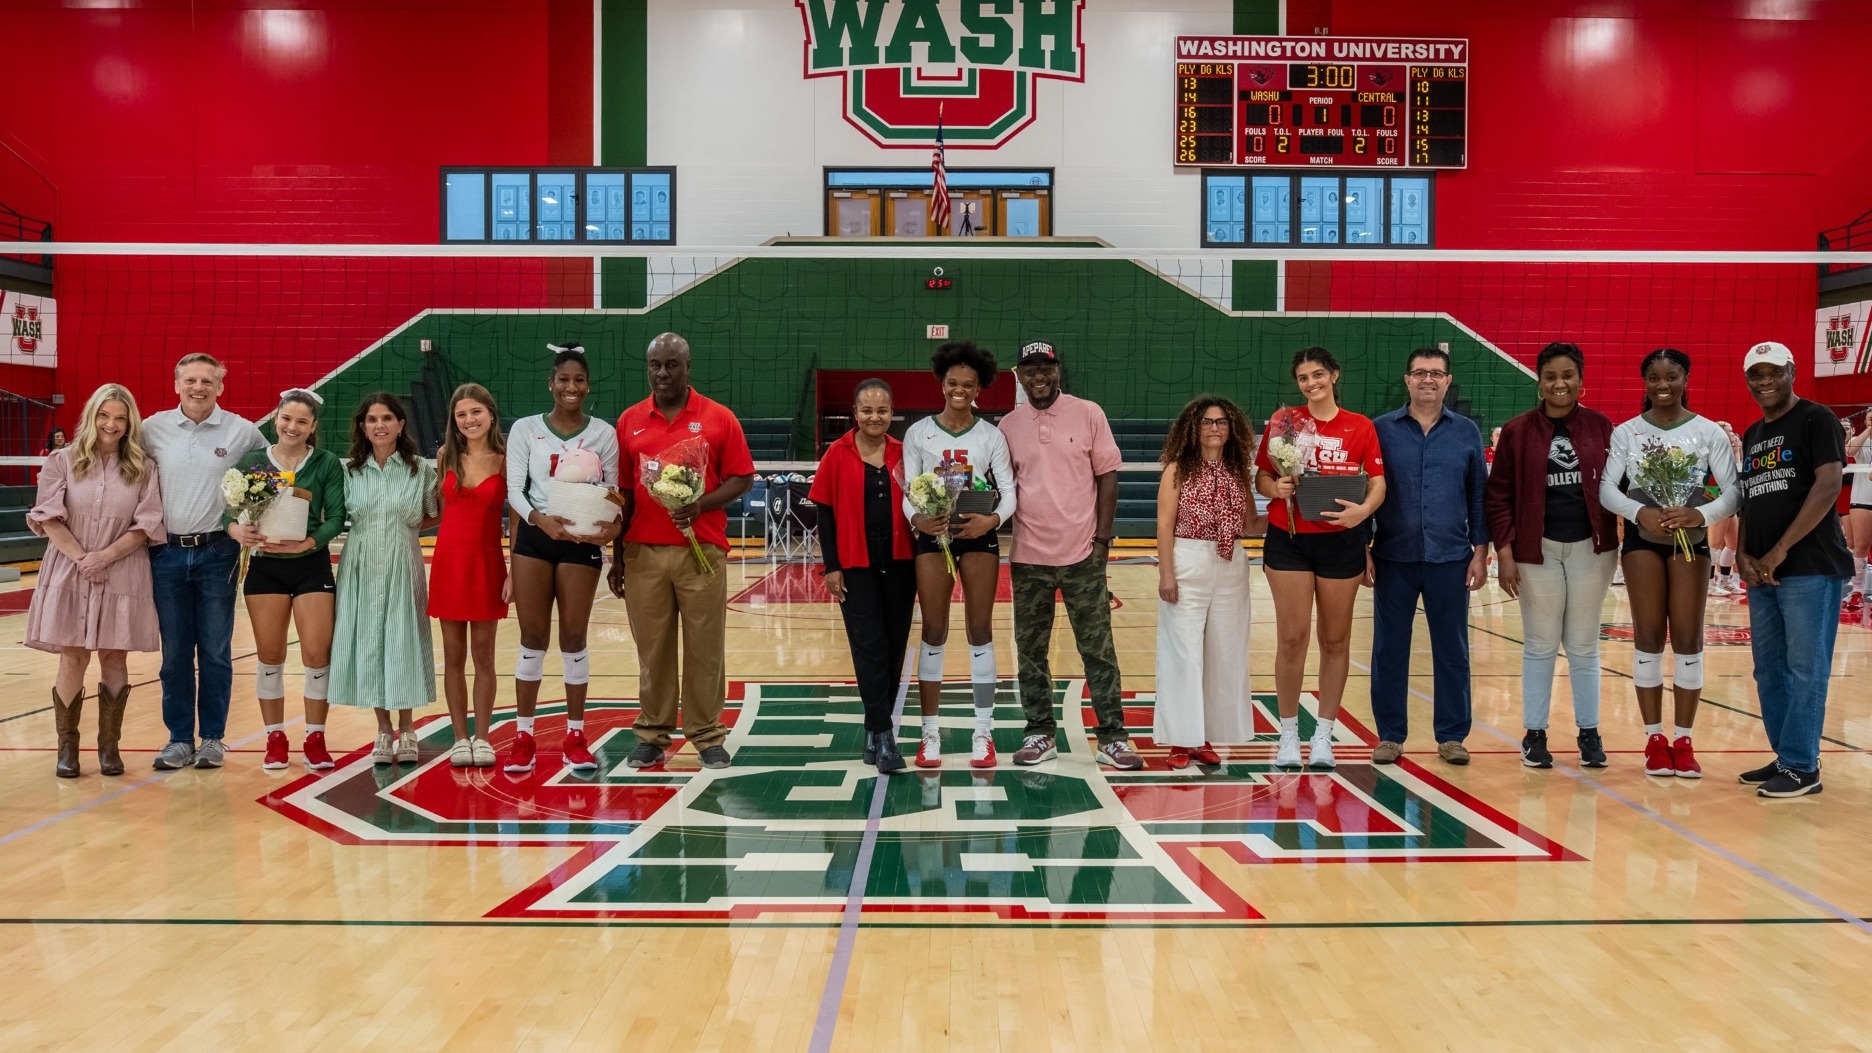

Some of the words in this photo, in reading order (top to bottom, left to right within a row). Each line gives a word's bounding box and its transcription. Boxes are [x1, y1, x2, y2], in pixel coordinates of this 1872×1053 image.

[805, 0, 1076, 73] WASH
[1179, 40, 1326, 57] WASHINGTON
[1333, 42, 1464, 59] UNIVERSITY
[1179, 64, 1196, 74] PLY
[1200, 64, 1212, 74] DG
[1215, 64, 1233, 75] KLS
[1307, 65, 1353, 87] 3:00
[1411, 68, 1428, 78] PLY
[1433, 68, 1444, 78] DG
[1448, 68, 1465, 78] KLS
[1184, 77, 1197, 90] 13
[1417, 81, 1429, 93] 10
[1184, 92, 1197, 102] 14
[1250, 91, 1280, 101] WASHU
[1309, 97, 1333, 105] PERIOD
[1358, 92, 1397, 103] CENTRAL
[1417, 96, 1429, 106] 11
[1184, 106, 1197, 119] 16
[1268, 104, 1280, 125] 0
[1383, 106, 1395, 126] 0
[1417, 110, 1429, 122] 13
[1180, 120, 1197, 132] 23
[1274, 128, 1292, 136] T.O.L.
[1417, 124, 1429, 135] 14
[1351, 129, 1370, 137] T.O.L.
[1376, 129, 1398, 137] FOULS
[1180, 135, 1196, 147] 25
[1253, 136, 1263, 152] 0
[1277, 136, 1288, 153] 2
[1355, 137, 1365, 154] 2
[1385, 137, 1395, 154] 0
[1416, 138, 1429, 151] 15
[1180, 149, 1196, 161] 26
[1376, 157, 1398, 165] SCORE
[1416, 152, 1428, 164] 17
[12, 317, 42, 340] WASH
[931, 327, 945, 337] EXIT
[1826, 327, 1854, 349] WASH
[1767, 436, 1784, 449] NEED
[942, 449, 968, 467] 15
[1744, 447, 1792, 472] Google
[1547, 471, 1582, 487] OLLEY
[1749, 471, 1772, 487] DAUGHTER
[1772, 468, 1796, 479] KNOWS
[1750, 479, 1788, 498] EVERYTHING
